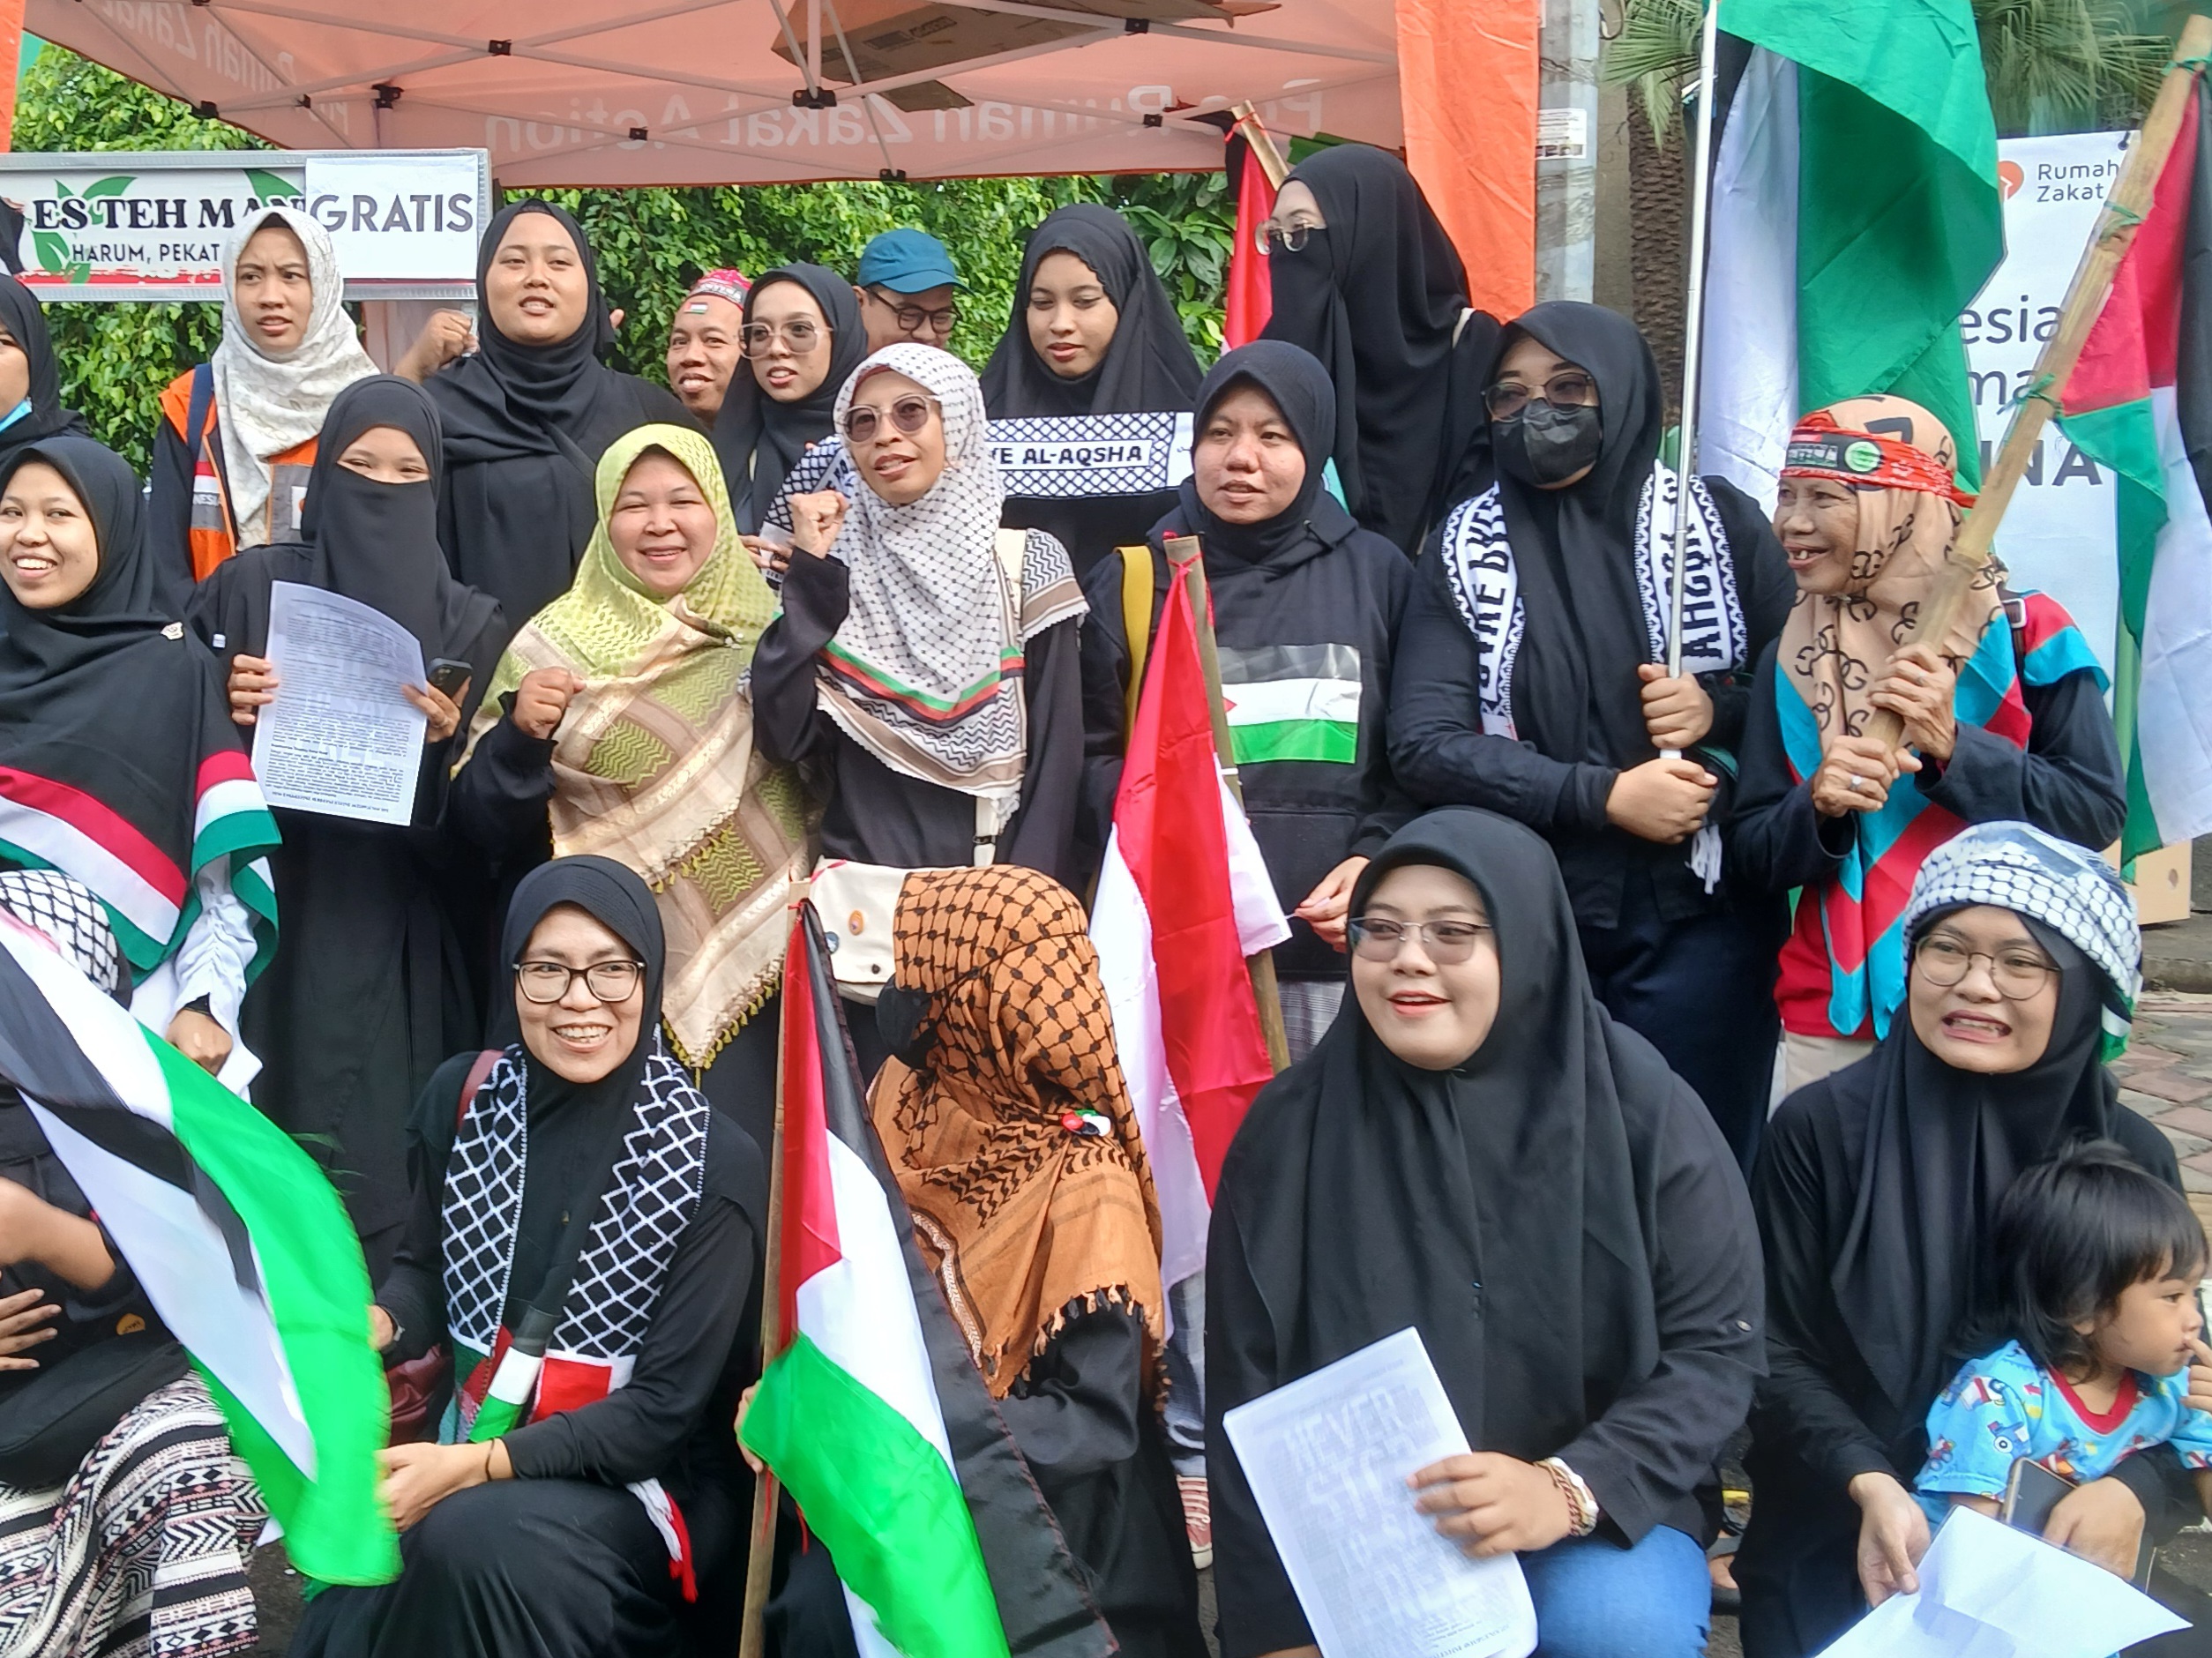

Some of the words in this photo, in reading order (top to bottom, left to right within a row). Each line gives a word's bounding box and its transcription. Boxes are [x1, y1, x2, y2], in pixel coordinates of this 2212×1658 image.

[2037, 159, 2119, 182] Rumah
[2036, 183, 2104, 204] Zakat
[33, 198, 88, 229] ES
[96, 198, 187, 229] TEH
[310, 192, 474, 233] GRATIS
[72, 243, 151, 265] HARUM,
[160, 243, 220, 262] PEKAT
[1022, 445, 1142, 467] AL-AQSHA
